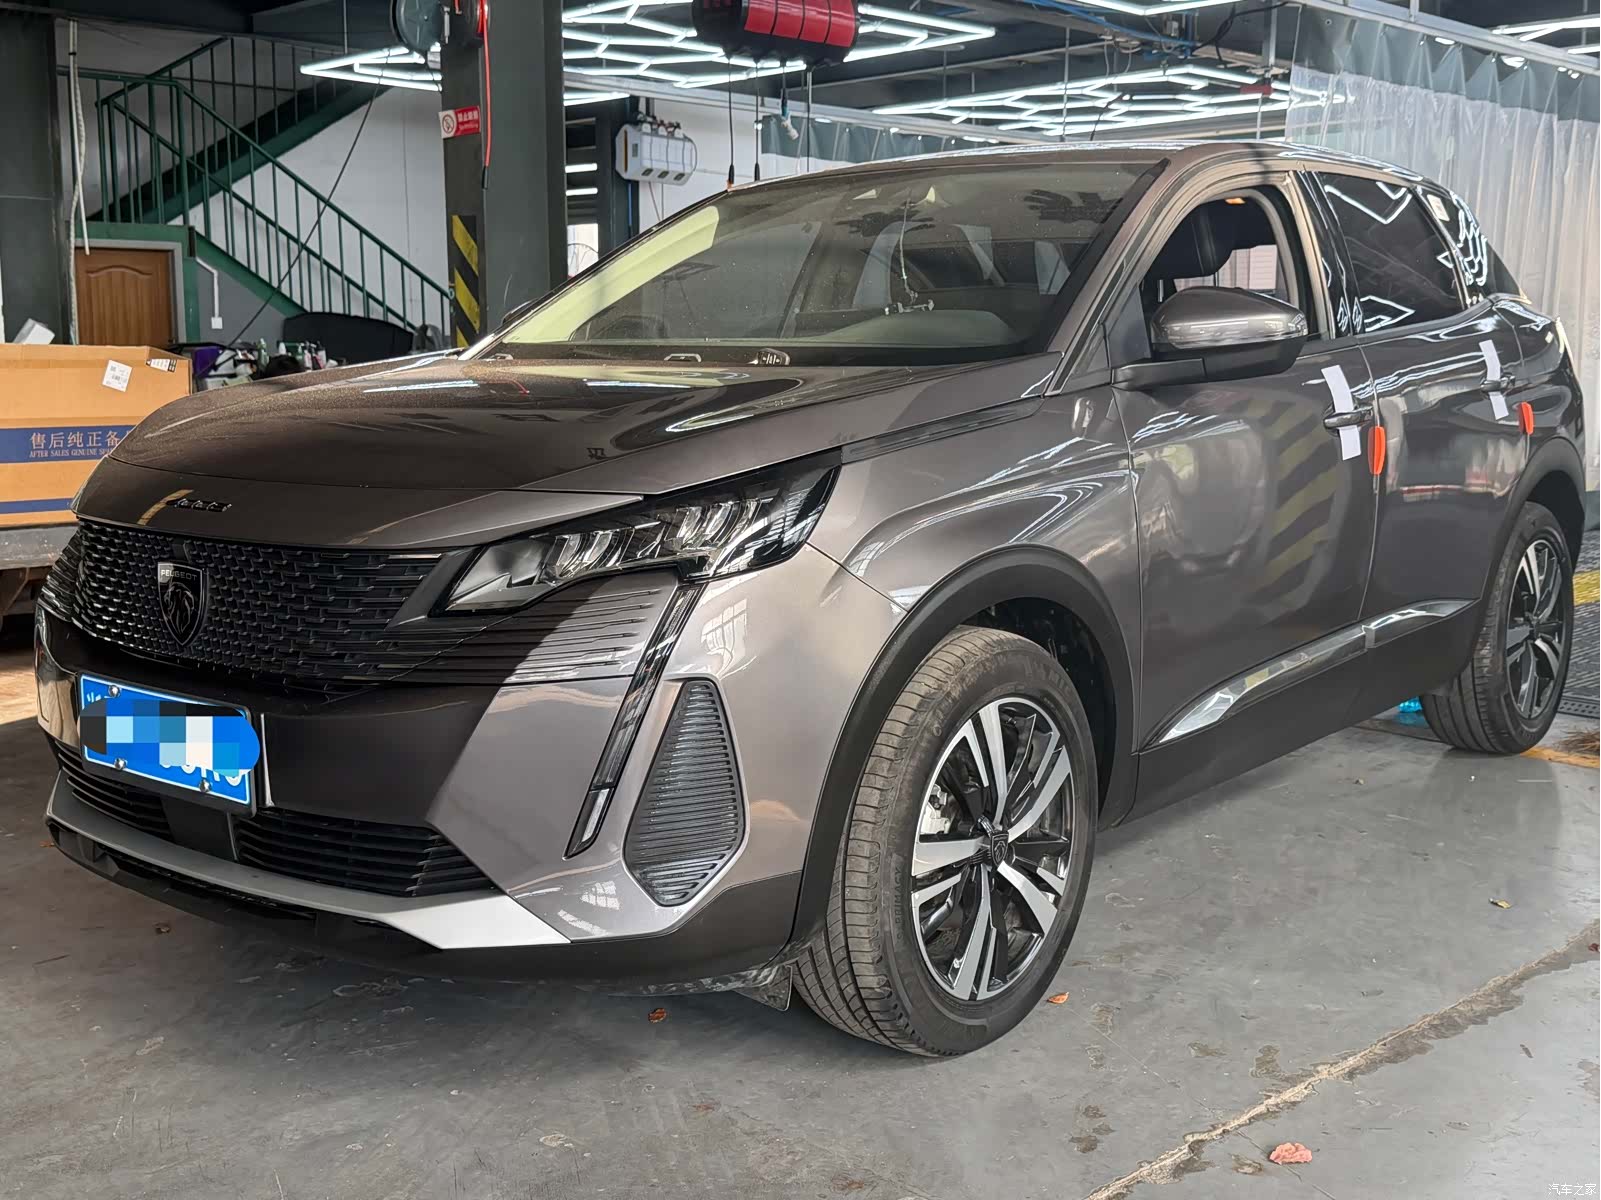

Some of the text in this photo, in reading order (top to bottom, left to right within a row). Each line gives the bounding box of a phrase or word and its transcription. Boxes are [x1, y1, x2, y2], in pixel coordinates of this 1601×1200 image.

[30, 431, 130, 450] 售后纯正备
[29, 450, 49, 458] AFTER
[50, 449, 70, 457] SALES
[71, 448, 98, 456] GENUINE
[160, 569, 198, 581] PEUGEOT
